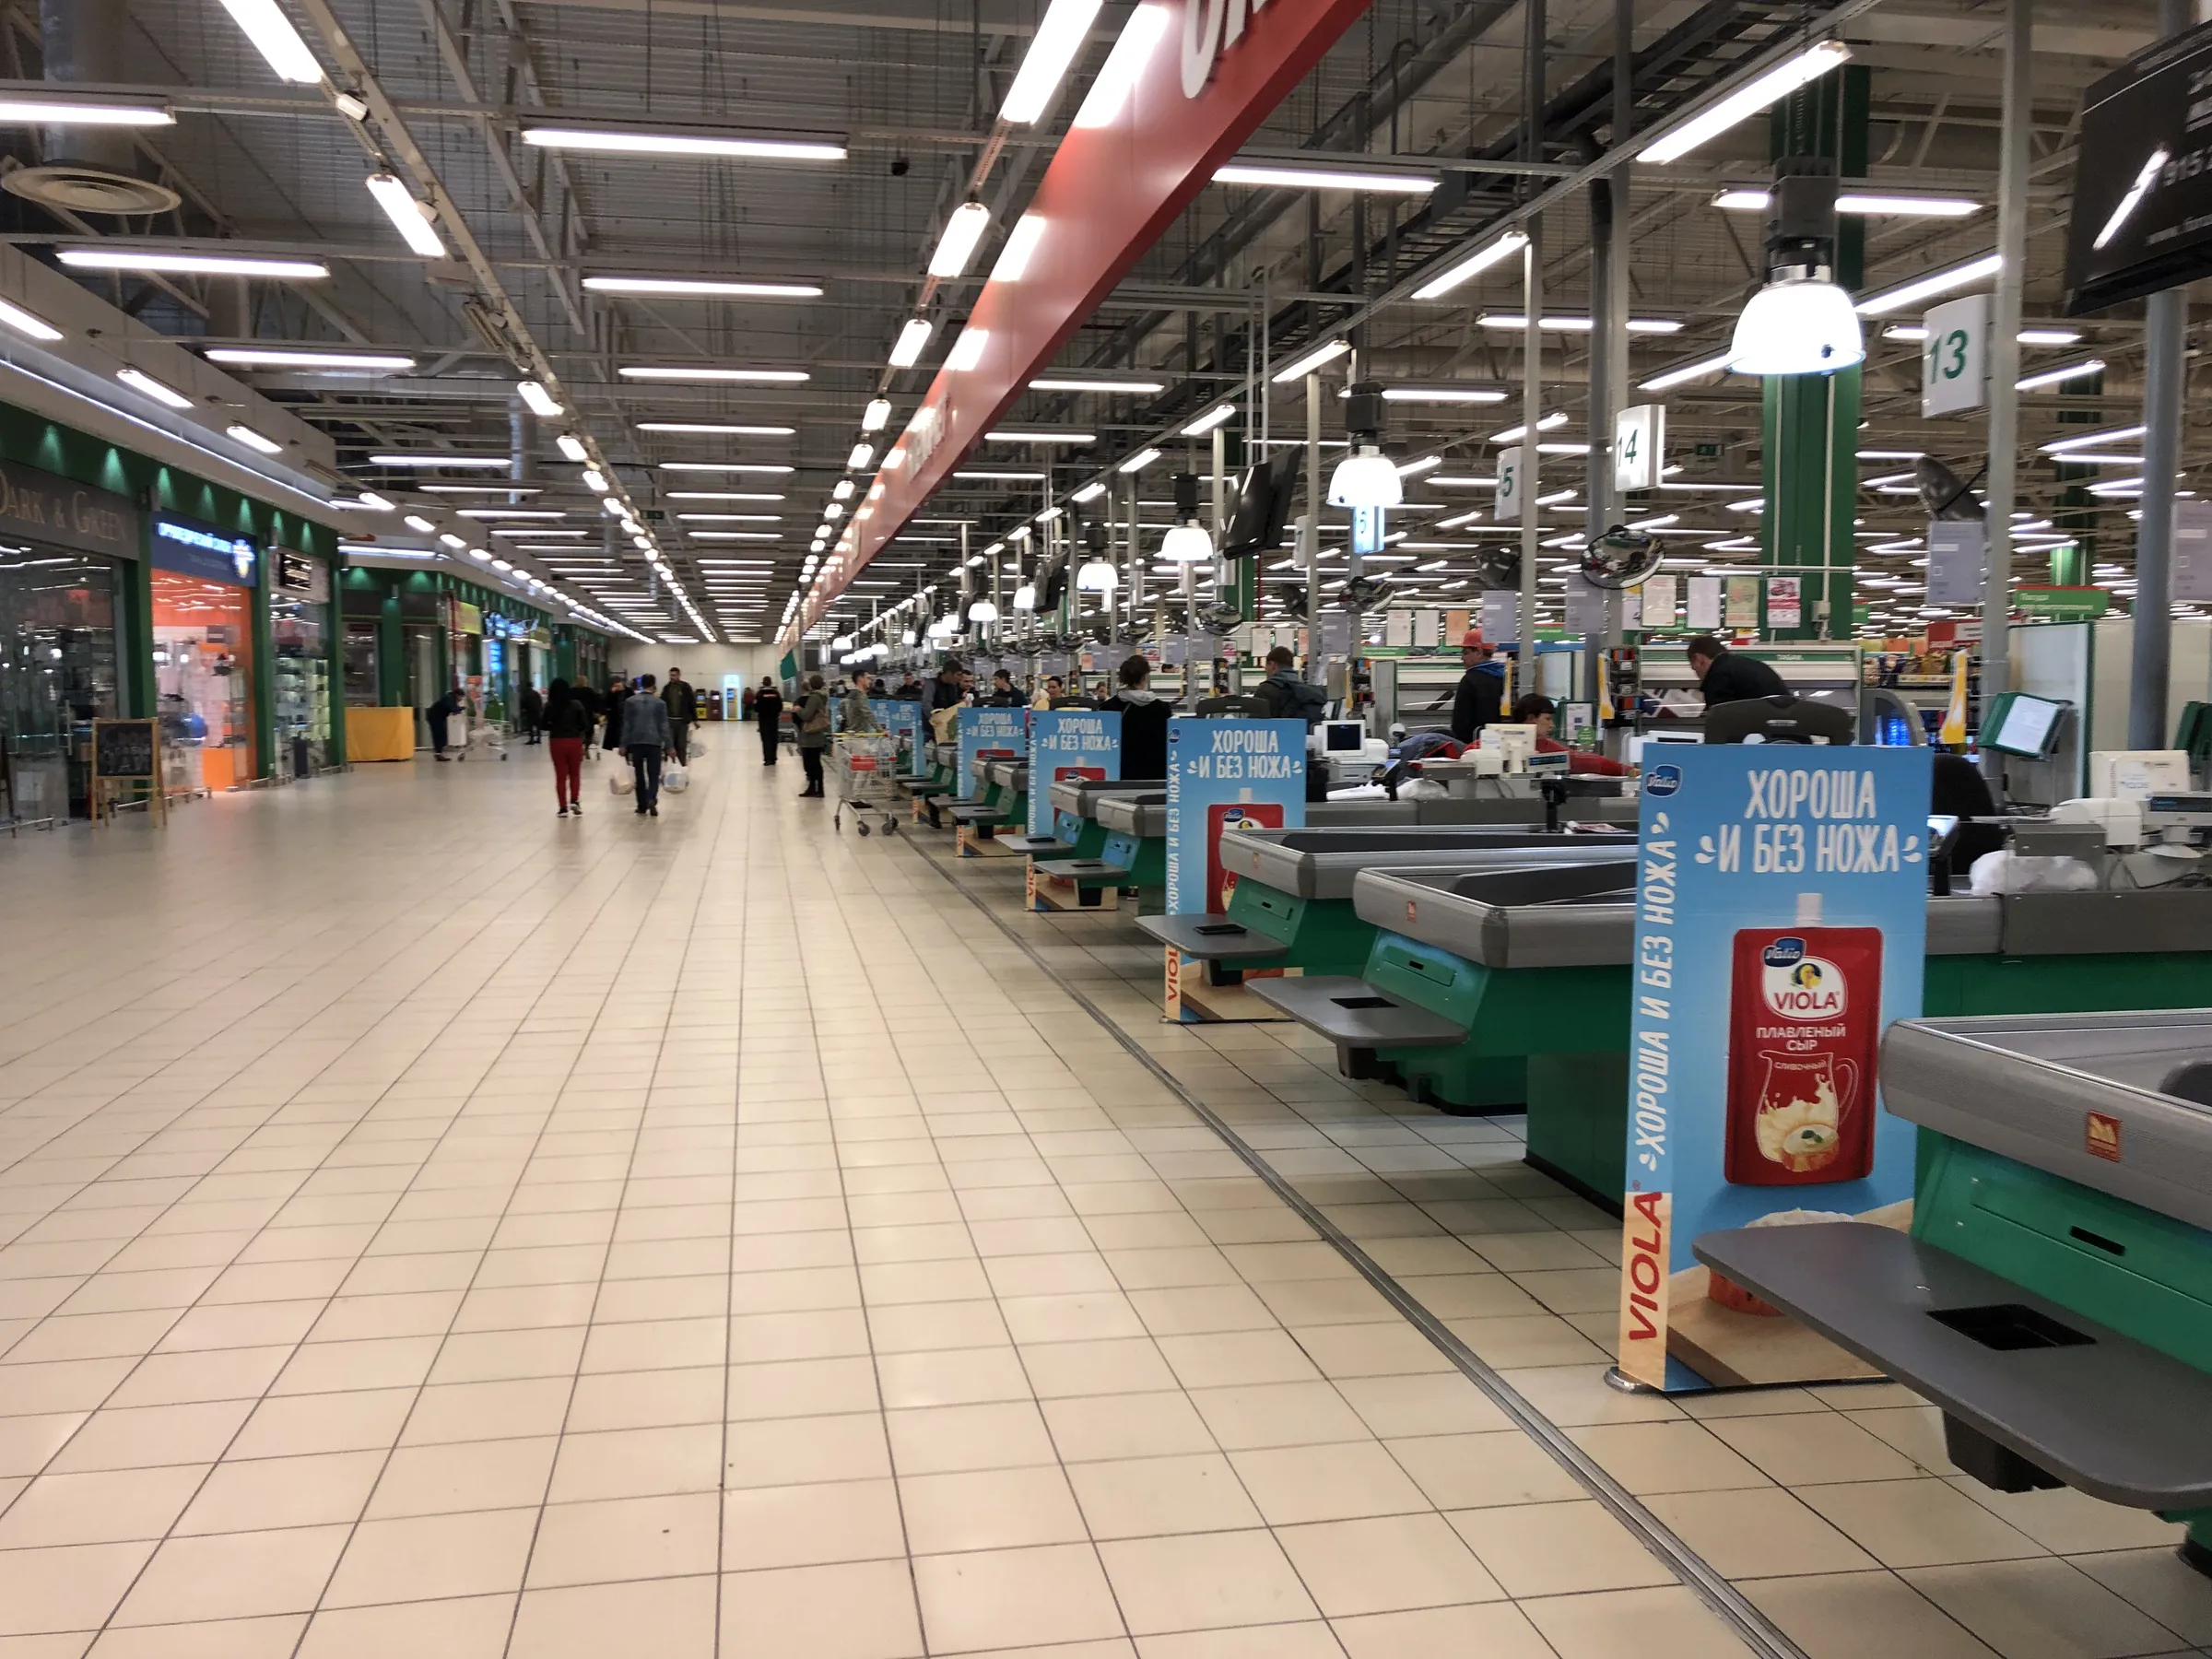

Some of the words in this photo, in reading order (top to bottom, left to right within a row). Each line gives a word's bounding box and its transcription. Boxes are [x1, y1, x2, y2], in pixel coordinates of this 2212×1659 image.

[1929, 329, 1968, 384] 13
[1617, 429, 1639, 467] 14
[1211, 730, 1279, 753] ХОРОША
[1169, 763, 1181, 803] НОЖА
[1198, 756, 1210, 778] И
[1216, 756, 1243, 778] БЕЗ
[1247, 755, 1291, 778] НОЖА
[1744, 769, 1877, 819] ХОРОША
[1168, 807, 1180, 833] БЕЗ
[1718, 824, 1741, 873] И
[1752, 824, 1806, 873] БЕЗ
[1815, 823, 1900, 873] НОЖА
[1168, 853, 1180, 911] ХОРОША
[1642, 840, 1677, 925] НОЖА
[1640, 935, 1674, 990] БЕЗ
[1639, 995, 1671, 1020] И
[1773, 992, 1839, 1010] VIOLA
[1756, 1023, 1846, 1039] ПЛАВЛЕНЫЙ
[1785, 1040, 1818, 1052] СЫР
[1635, 1030, 1670, 1157] ХОРОША
[1629, 1191, 1663, 1341] VIOLA
